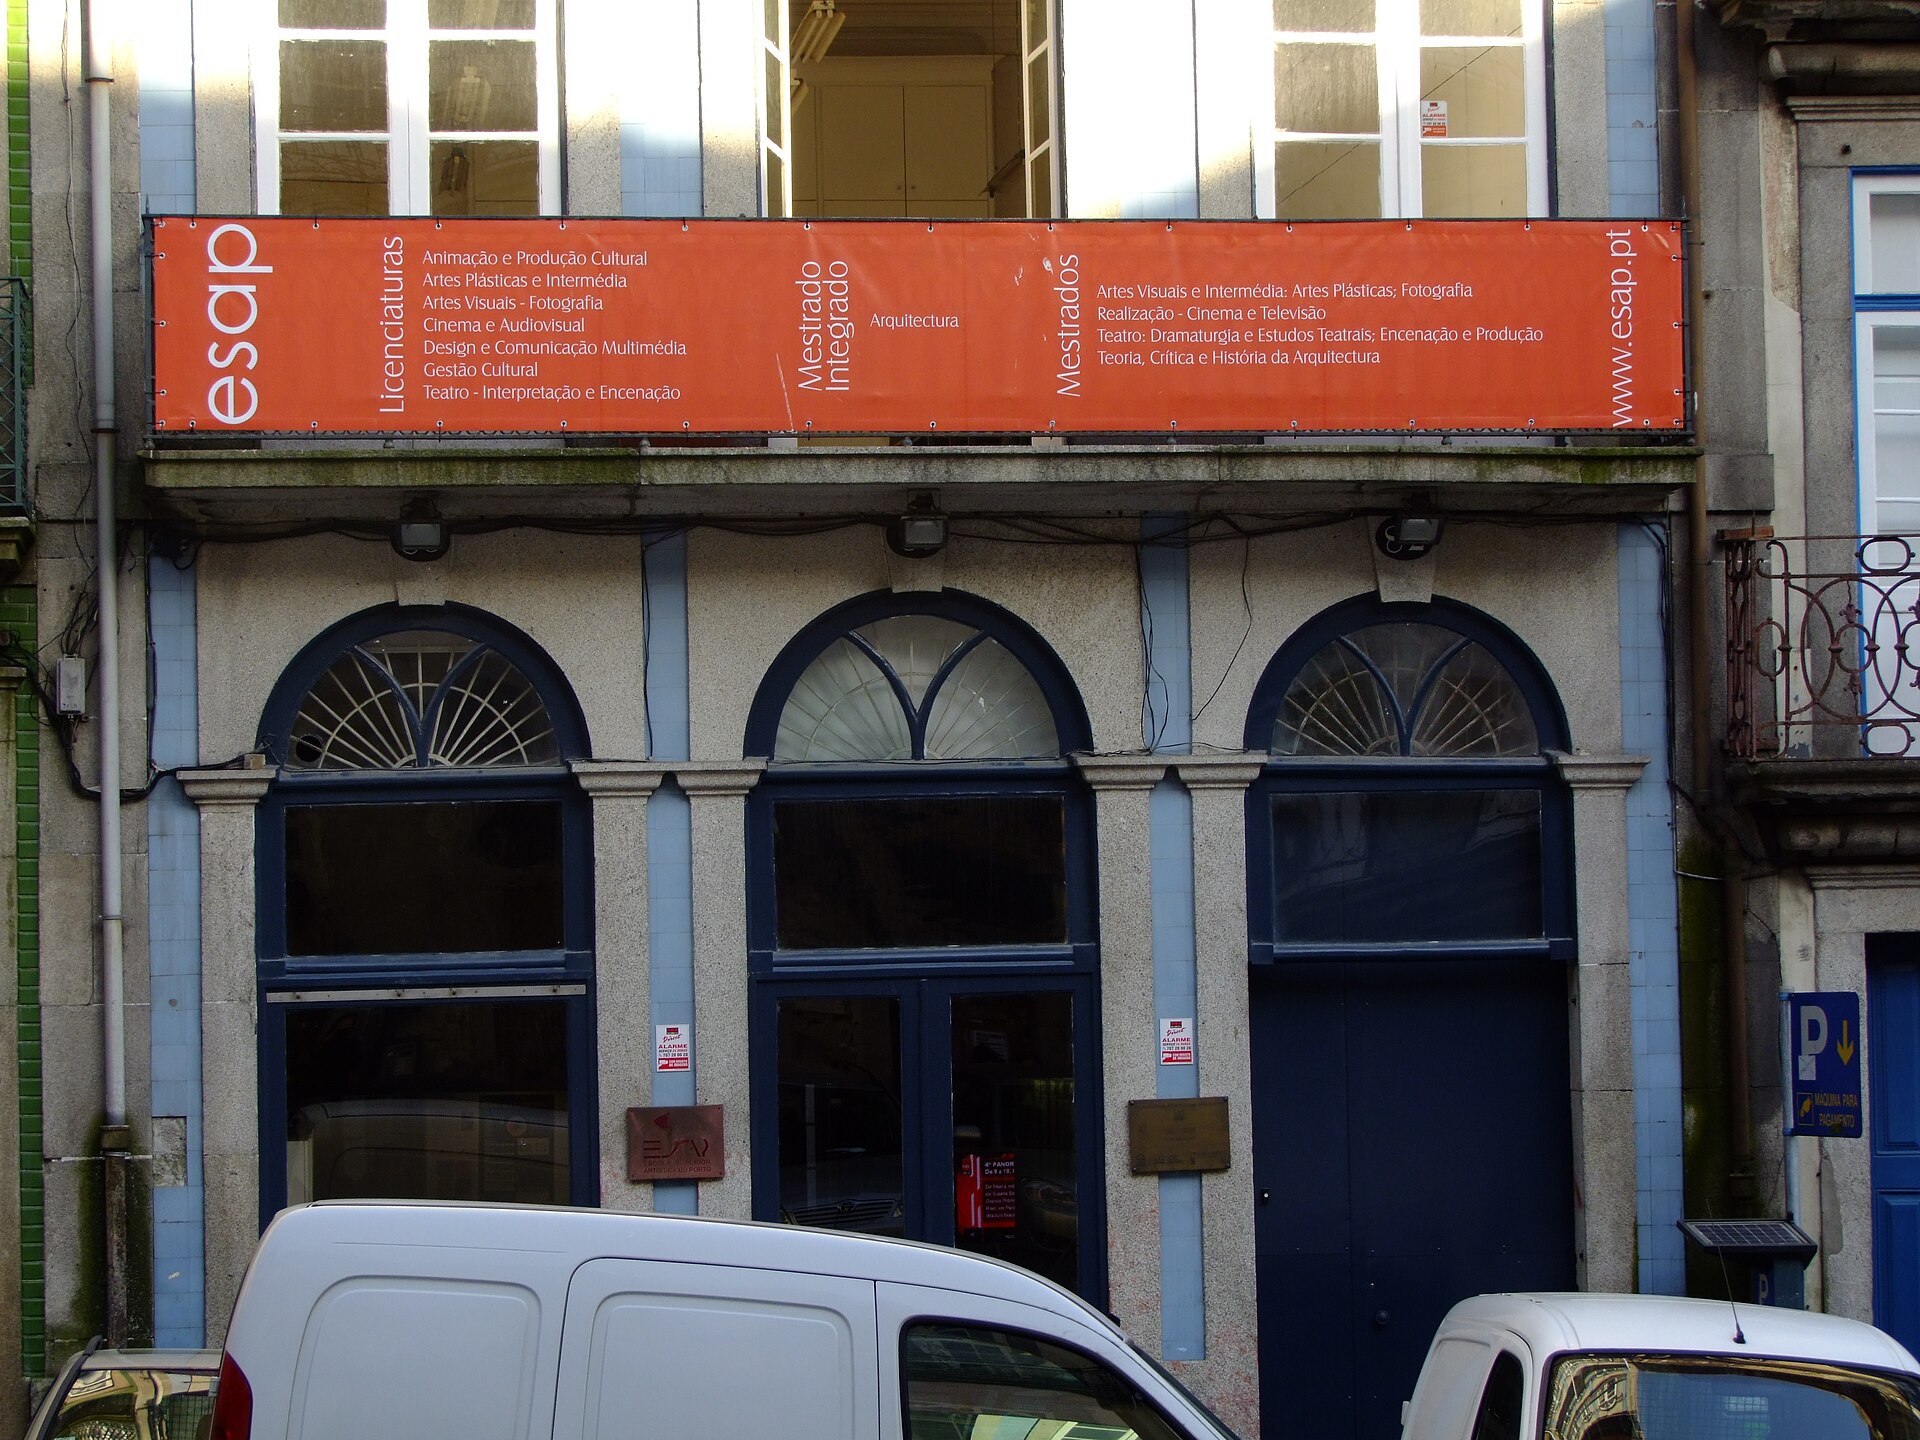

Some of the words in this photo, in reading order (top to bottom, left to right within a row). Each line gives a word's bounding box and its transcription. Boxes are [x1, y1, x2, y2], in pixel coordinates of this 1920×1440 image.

[423, 251, 497, 268] Animação
[503, 254, 512, 265] e
[517, 250, 586, 268] Produção
[592, 251, 647, 265] Cultural
[423, 273, 461, 287] Artes
[466, 273, 527, 287] Plásticas
[532, 276, 541, 287] e
[547, 273, 627, 287] Intermédia
[1097, 285, 1134, 298] Artes
[1137, 285, 1187, 298] Visuais
[1192, 287, 1200, 298] e
[1206, 283, 1287, 298] Intermédia:
[1292, 284, 1328, 298] Artes
[1334, 283, 1396, 298] Plásticas;
[1402, 282, 1473, 300] Fotografia
[423, 296, 461, 309] Artes
[465, 296, 516, 309] Visuais
[530, 295, 603, 313] Fotografia
[870, 313, 959, 330] Arquitectura
[1098, 306, 1174, 323] Realização
[1187, 306, 1243, 320] Cinema
[1247, 309, 1256, 320] e
[1260, 305, 1326, 320] Televisão
[207, 224, 273, 424] esap
[380, 237, 404, 412] Licenciaturas
[424, 318, 481, 332] Cinema
[486, 321, 495, 332] e
[500, 317, 584, 332] Audiovisual
[795, 261, 822, 391] Mestrado
[822, 261, 854, 390] Integrado
[1053, 255, 1080, 396] Mestrados
[1606, 229, 1637, 427] www.esap.pt
[1097, 329, 1145, 342] Teatro:
[1151, 329, 1240, 345] Dramaturgia
[1244, 331, 1253, 342] e
[1259, 327, 1314, 342] Estudos
[1317, 328, 1375, 342] Teatrais;
[1381, 327, 1458, 344] Encenação
[1463, 330, 1471, 341] e
[1477, 326, 1543, 344] Produção
[424, 340, 475, 357] Design
[481, 343, 490, 354] e
[495, 340, 597, 357] Comunicação
[602, 340, 687, 355] Multimédia
[1097, 351, 1145, 366] Teoria,
[1150, 350, 1194, 364] Crítica
[1199, 353, 1207, 364] e
[1213, 350, 1267, 364] História
[1271, 349, 1289, 364] da
[1293, 350, 1380, 366] Arquitectura
[424, 363, 477, 377] Gestão
[482, 362, 537, 376] Cultural
[423, 385, 469, 399] Teatro
[483, 385, 581, 402] Interpretação
[586, 388, 595, 399] e
[601, 385, 680, 402] Encenação
[1799, 1005, 1828, 1057] P
[1841, 1094, 1857, 1108] PARA
[1819, 1113, 1855, 1128] PAGAMENTO
